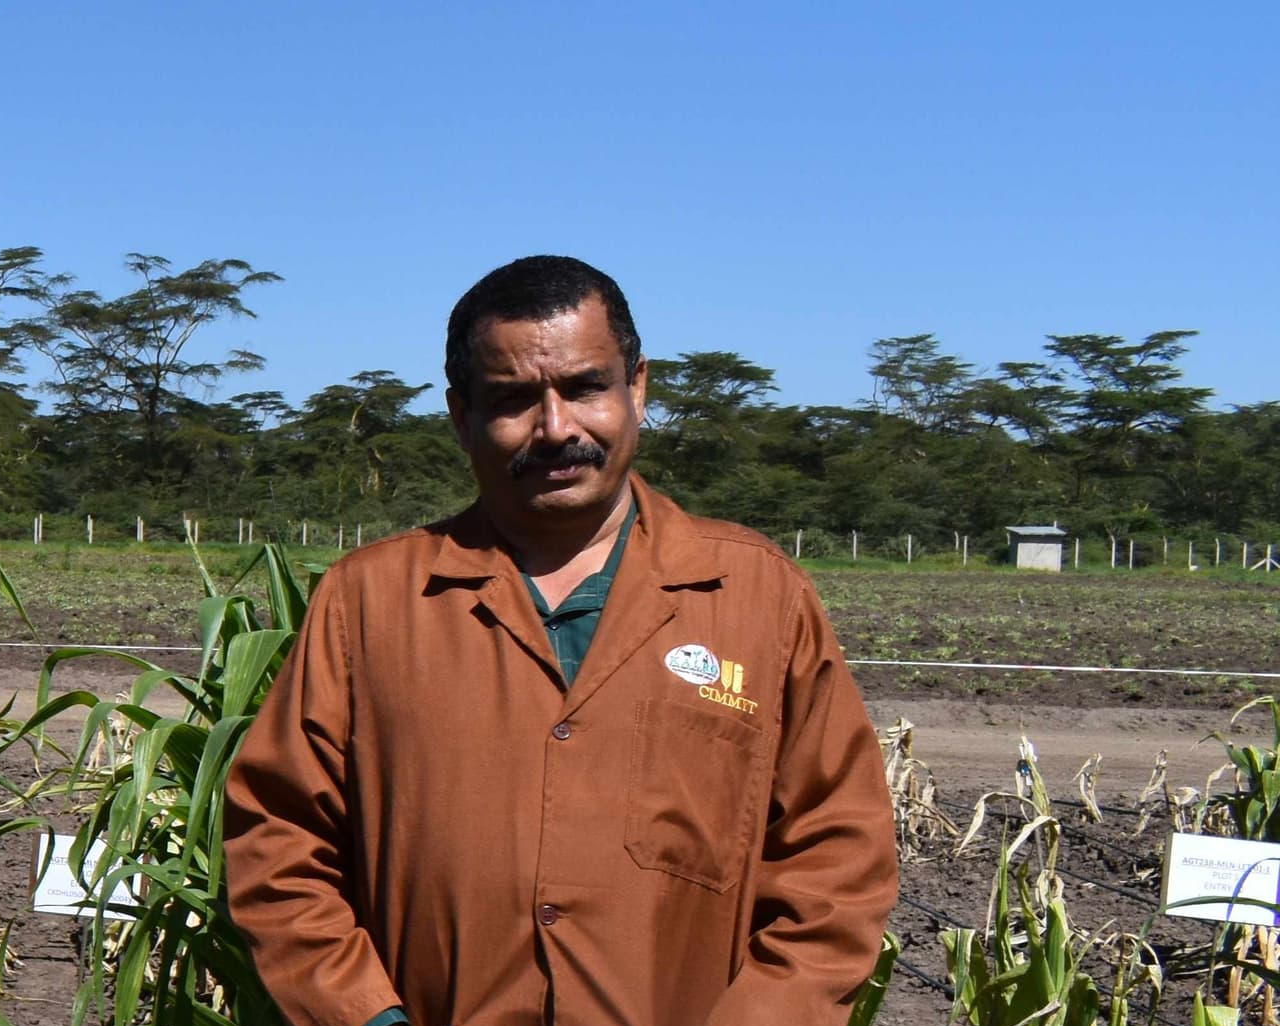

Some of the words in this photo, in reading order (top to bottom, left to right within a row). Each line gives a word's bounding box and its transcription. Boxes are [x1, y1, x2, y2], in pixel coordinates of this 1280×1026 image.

[698, 685, 758, 714] CIMMYT
[1212, 871, 1233, 880] PLOT
[1204, 882, 1232, 893] ENTRY
